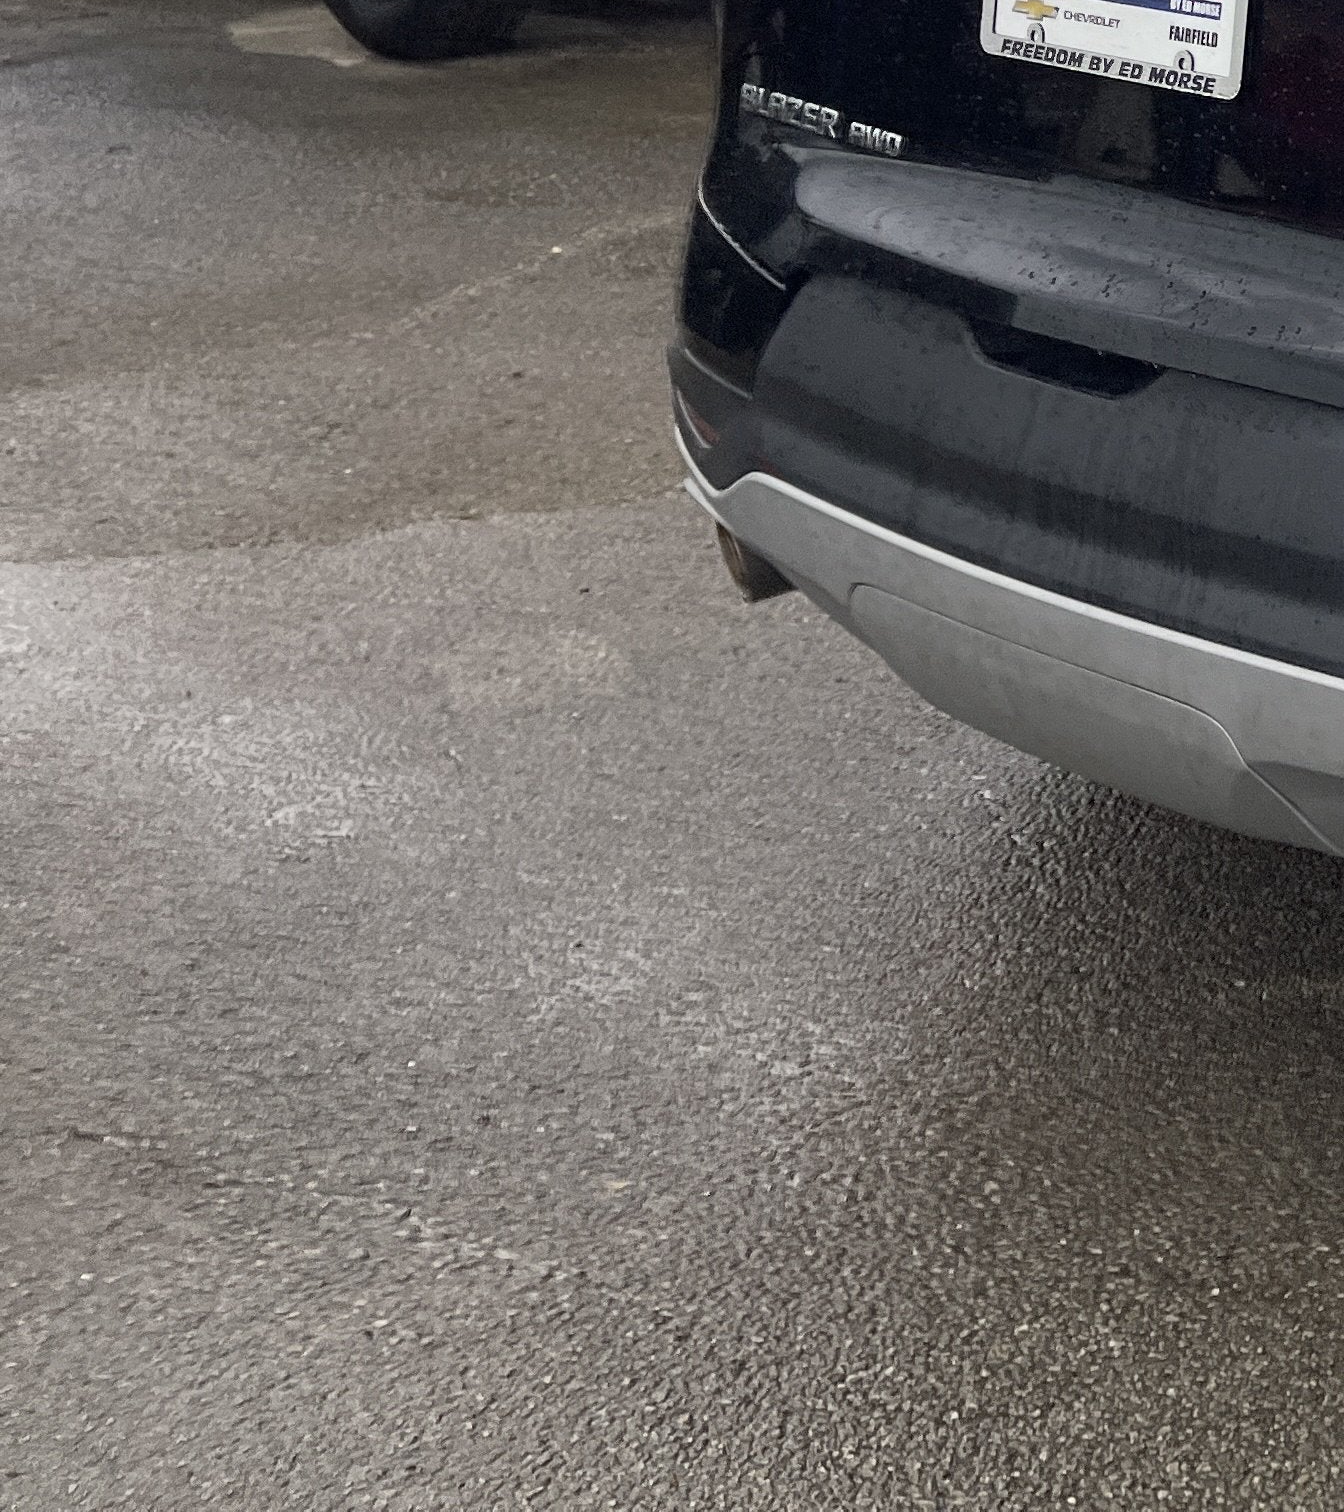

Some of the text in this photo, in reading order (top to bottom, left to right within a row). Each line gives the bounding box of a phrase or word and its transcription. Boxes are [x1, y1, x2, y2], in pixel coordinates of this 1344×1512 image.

[1063, 9, 1121, 29] CHEVROLET
[1168, 25, 1219, 48] FAIRFIELD
[1000, 39, 1217, 94] FREEDOM BY ED MORSE
